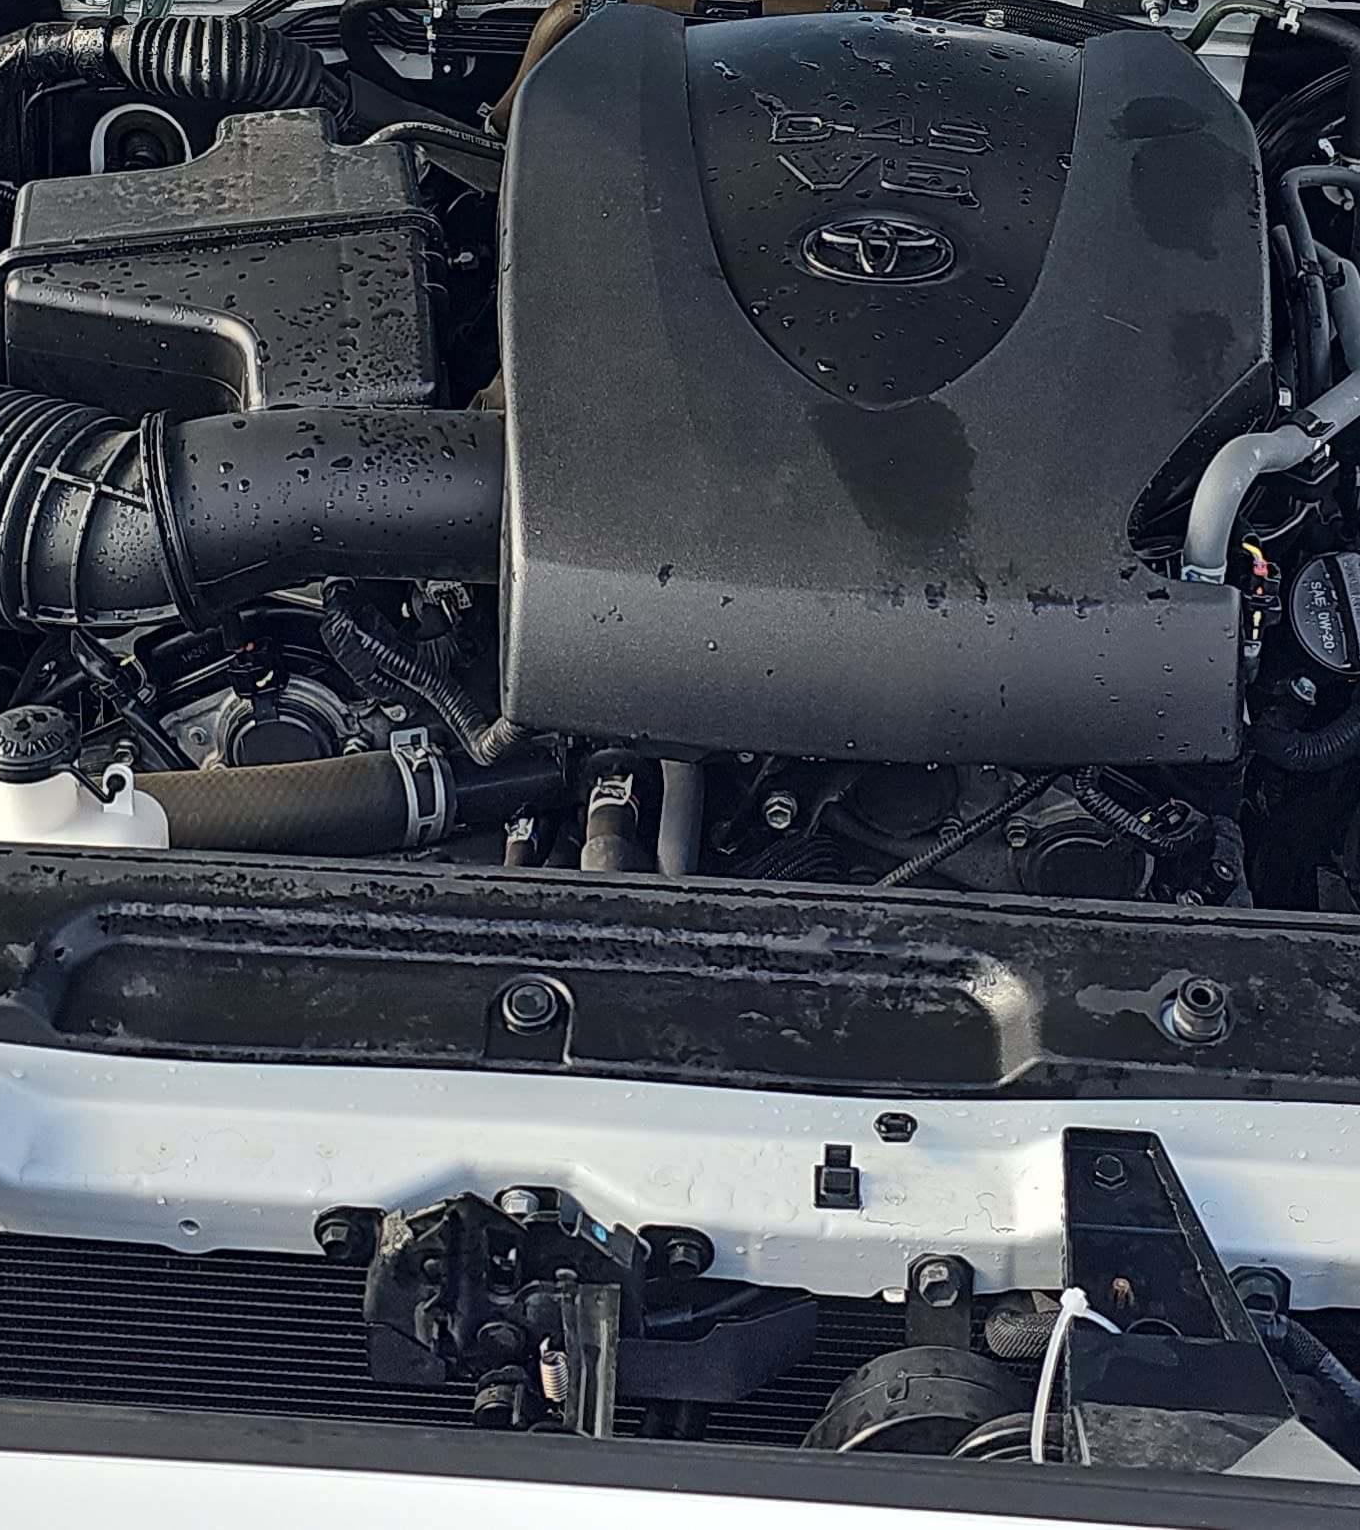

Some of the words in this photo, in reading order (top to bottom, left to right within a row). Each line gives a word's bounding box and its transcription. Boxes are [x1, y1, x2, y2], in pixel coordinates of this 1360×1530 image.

[769, 112, 994, 154] D-4S
[777, 152, 976, 202] V6
[1310, 581, 1327, 607] SAE
[1318, 612, 1335, 649] 0W-20
